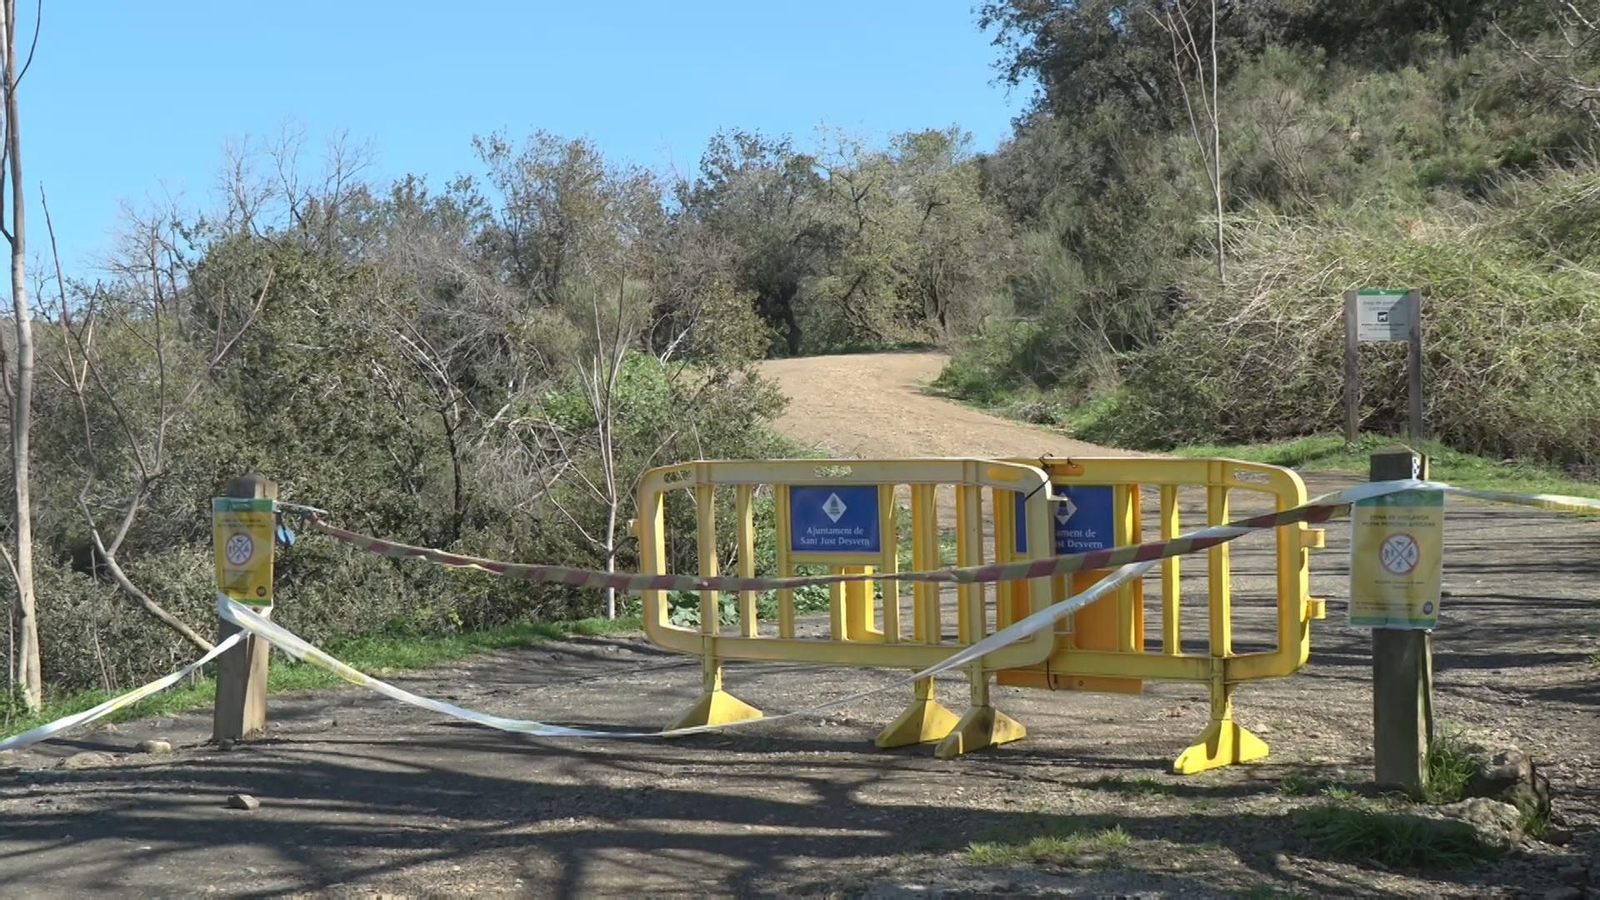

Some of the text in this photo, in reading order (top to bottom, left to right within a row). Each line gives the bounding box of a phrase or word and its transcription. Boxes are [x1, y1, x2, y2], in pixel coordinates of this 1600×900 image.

[806, 526, 864, 536] Ajuntament de
[1056, 528, 1097, 538] ament de
[800, 537, 871, 547] Sant Just Desvern
[1067, 539, 1103, 548] Desvern
